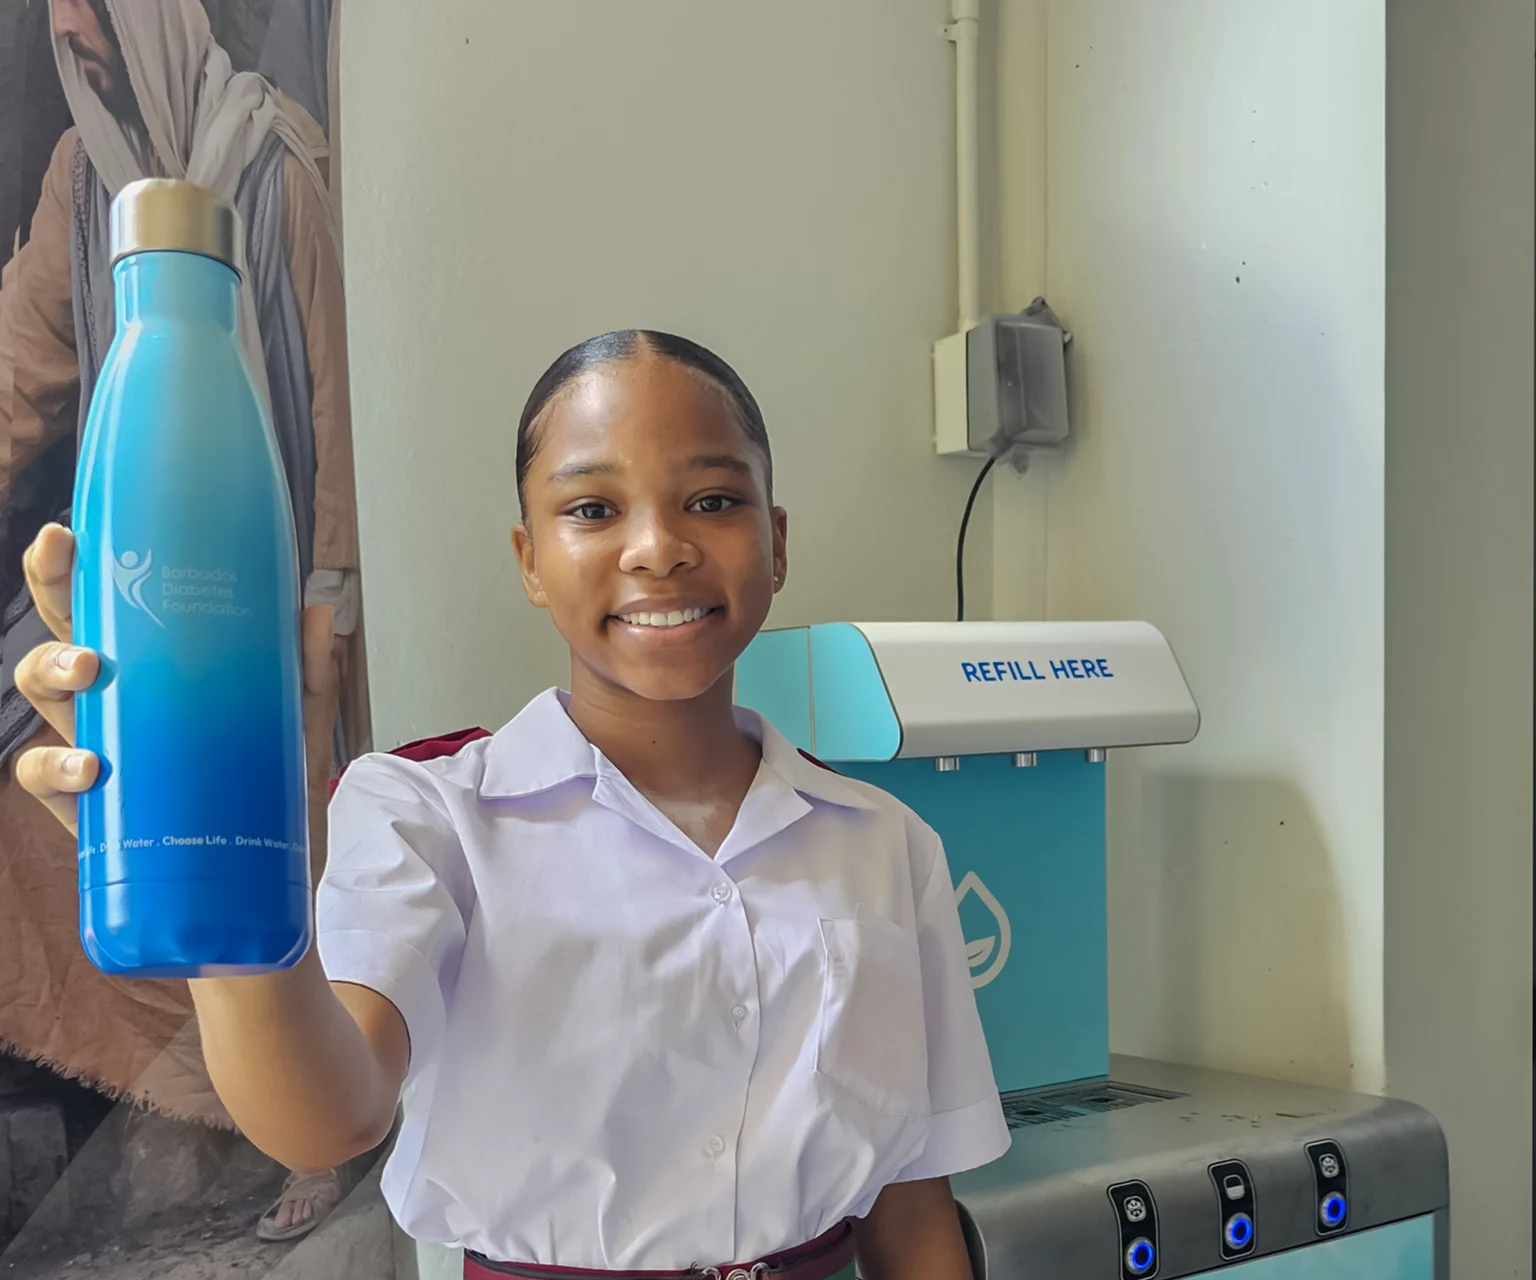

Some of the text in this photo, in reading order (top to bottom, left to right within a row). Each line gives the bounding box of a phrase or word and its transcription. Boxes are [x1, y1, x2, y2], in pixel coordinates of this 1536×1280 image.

[162, 566, 238, 584] Barbados
[162, 582, 235, 599] Diabetes
[163, 599, 254, 618] Foundation
[961, 658, 1114, 683] REFILL HERE
[123, 838, 155, 849] Water
[162, 835, 204, 845] Choose
[205, 835, 227, 845] Life
[235, 835, 263, 846] Drink
